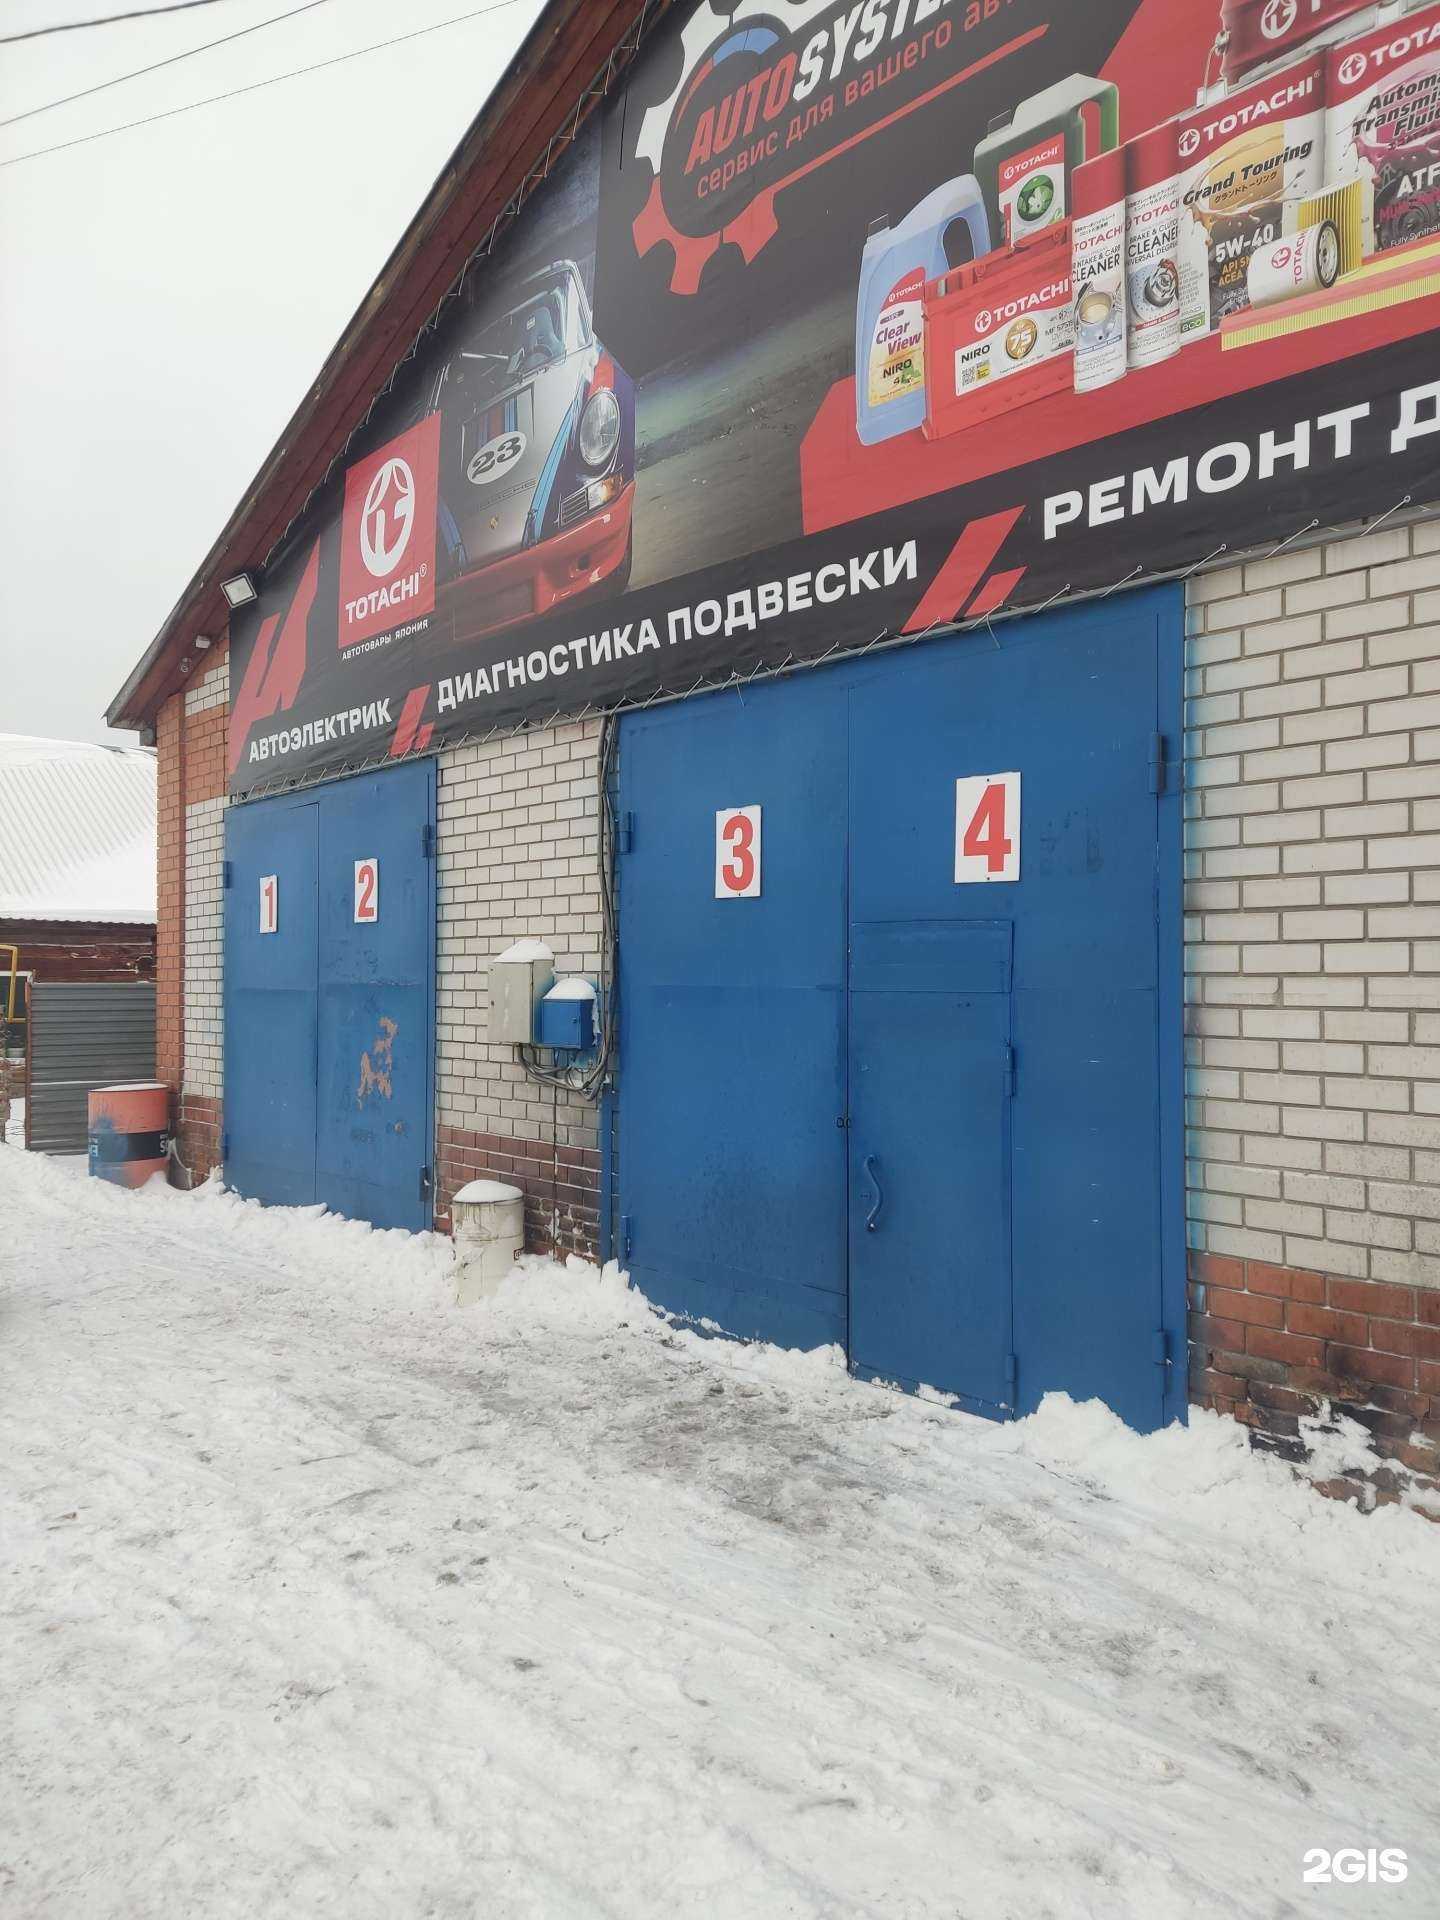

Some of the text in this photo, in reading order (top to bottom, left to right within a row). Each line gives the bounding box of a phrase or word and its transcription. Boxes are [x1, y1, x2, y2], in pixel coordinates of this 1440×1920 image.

[697, 131, 779, 199] сервис
[785, 94, 835, 150] для
[844, 20, 952, 107] вашего
[1203, 76, 1313, 141] TOTACHI
[1016, 146, 1058, 173] TOTACHI
[1182, 171, 1235, 206] Grand
[1241, 140, 1313, 181] Touring
[1215, 223, 1274, 263] 5W-40
[993, 278, 1070, 322] TOTACHI
[876, 321, 910, 345] Clear
[888, 331, 921, 356] View
[961, 344, 991, 363] NIRO
[1010, 328, 1033, 352] 75
[883, 358, 912, 379] NIRO
[472, 436, 522, 480] 23
[1044, 402, 1370, 540] РЕМОНТ
[345, 571, 419, 624] TOTACHI
[342, 619, 429, 661] АВТОТОВАРЫ ЯПОНИЯ
[437, 540, 917, 713] ДИАГНОСТИКА ПОДВЕСКИ
[248, 697, 392, 763] АВТОЭЛЕКТРИК
[963, 783, 1012, 873] 4
[722, 815, 755, 892] 3
[264, 881, 274, 928] 1
[358, 865, 375, 918] 2
